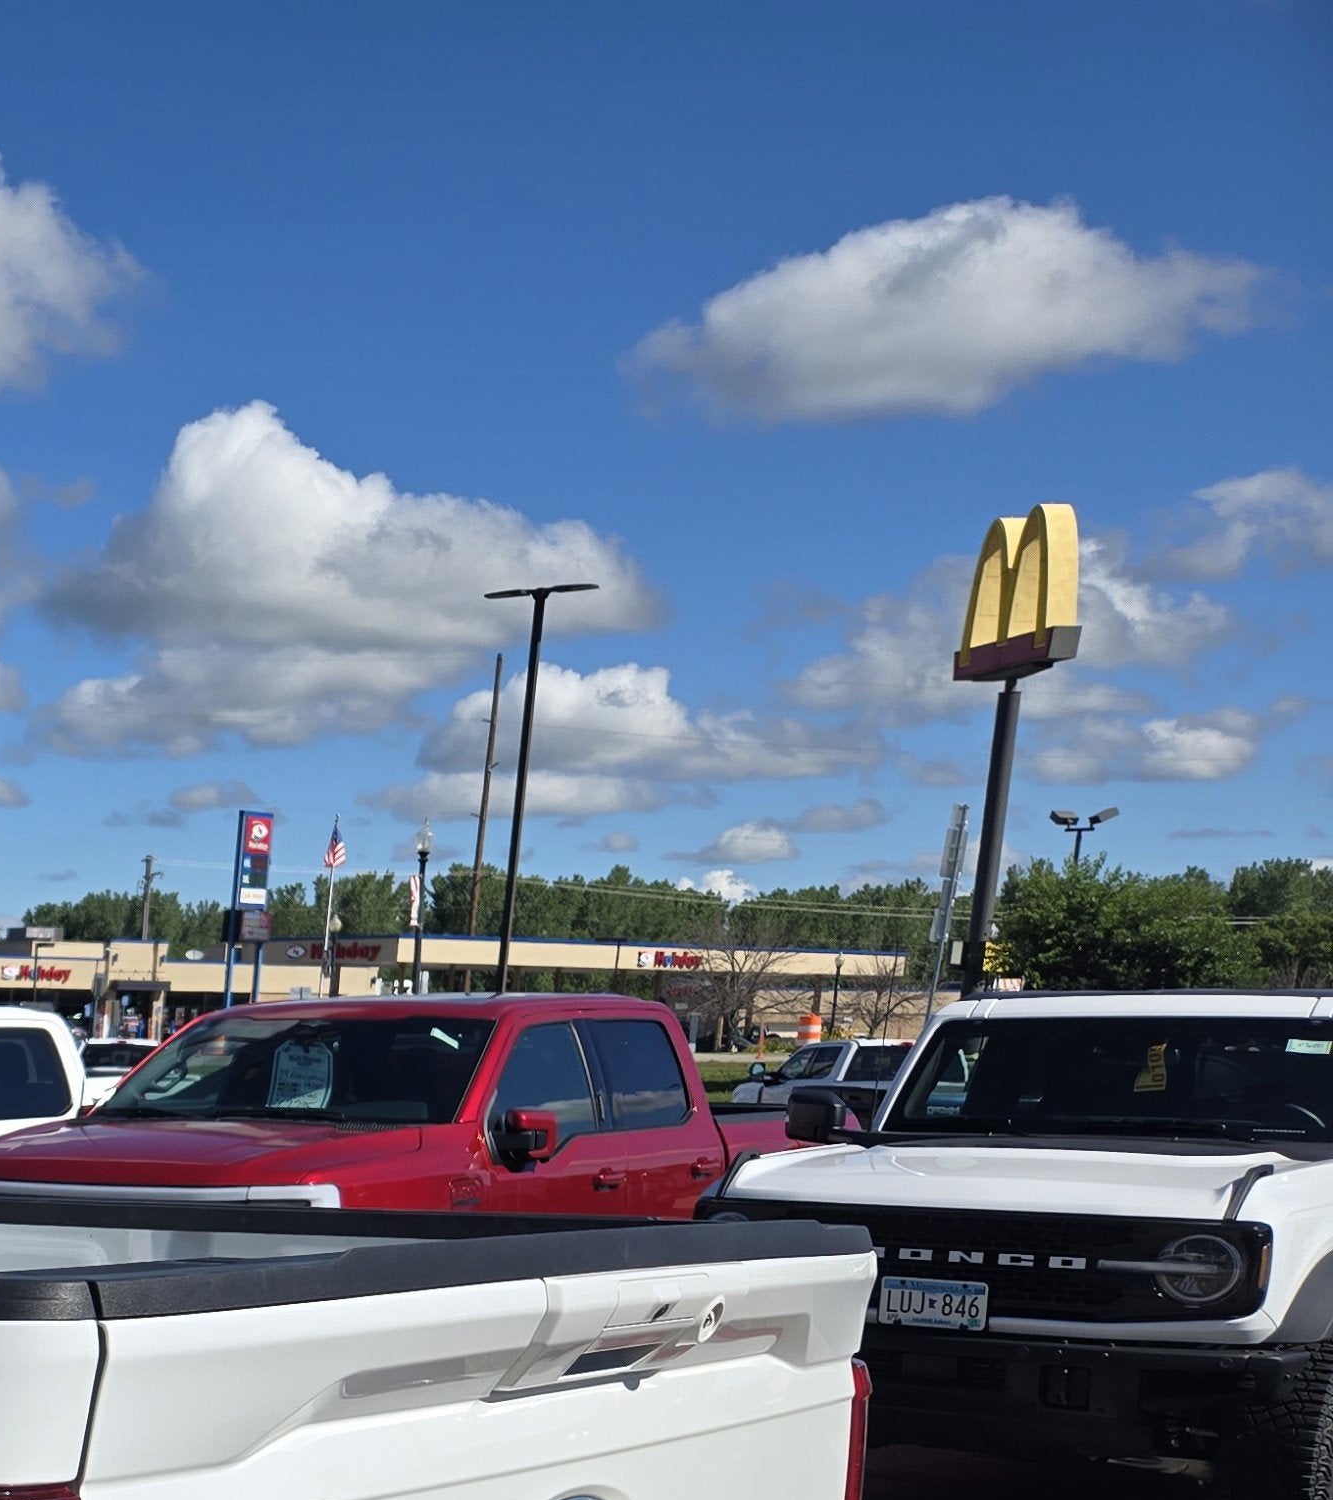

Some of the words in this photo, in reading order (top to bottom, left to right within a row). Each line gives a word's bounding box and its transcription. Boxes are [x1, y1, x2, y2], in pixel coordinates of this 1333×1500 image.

[309, 942, 382, 962] Hliday
[872, 1246, 1087, 1270] ONCO
[886, 1289, 925, 1314] LUJ
[941, 1293, 980, 1319] 846
